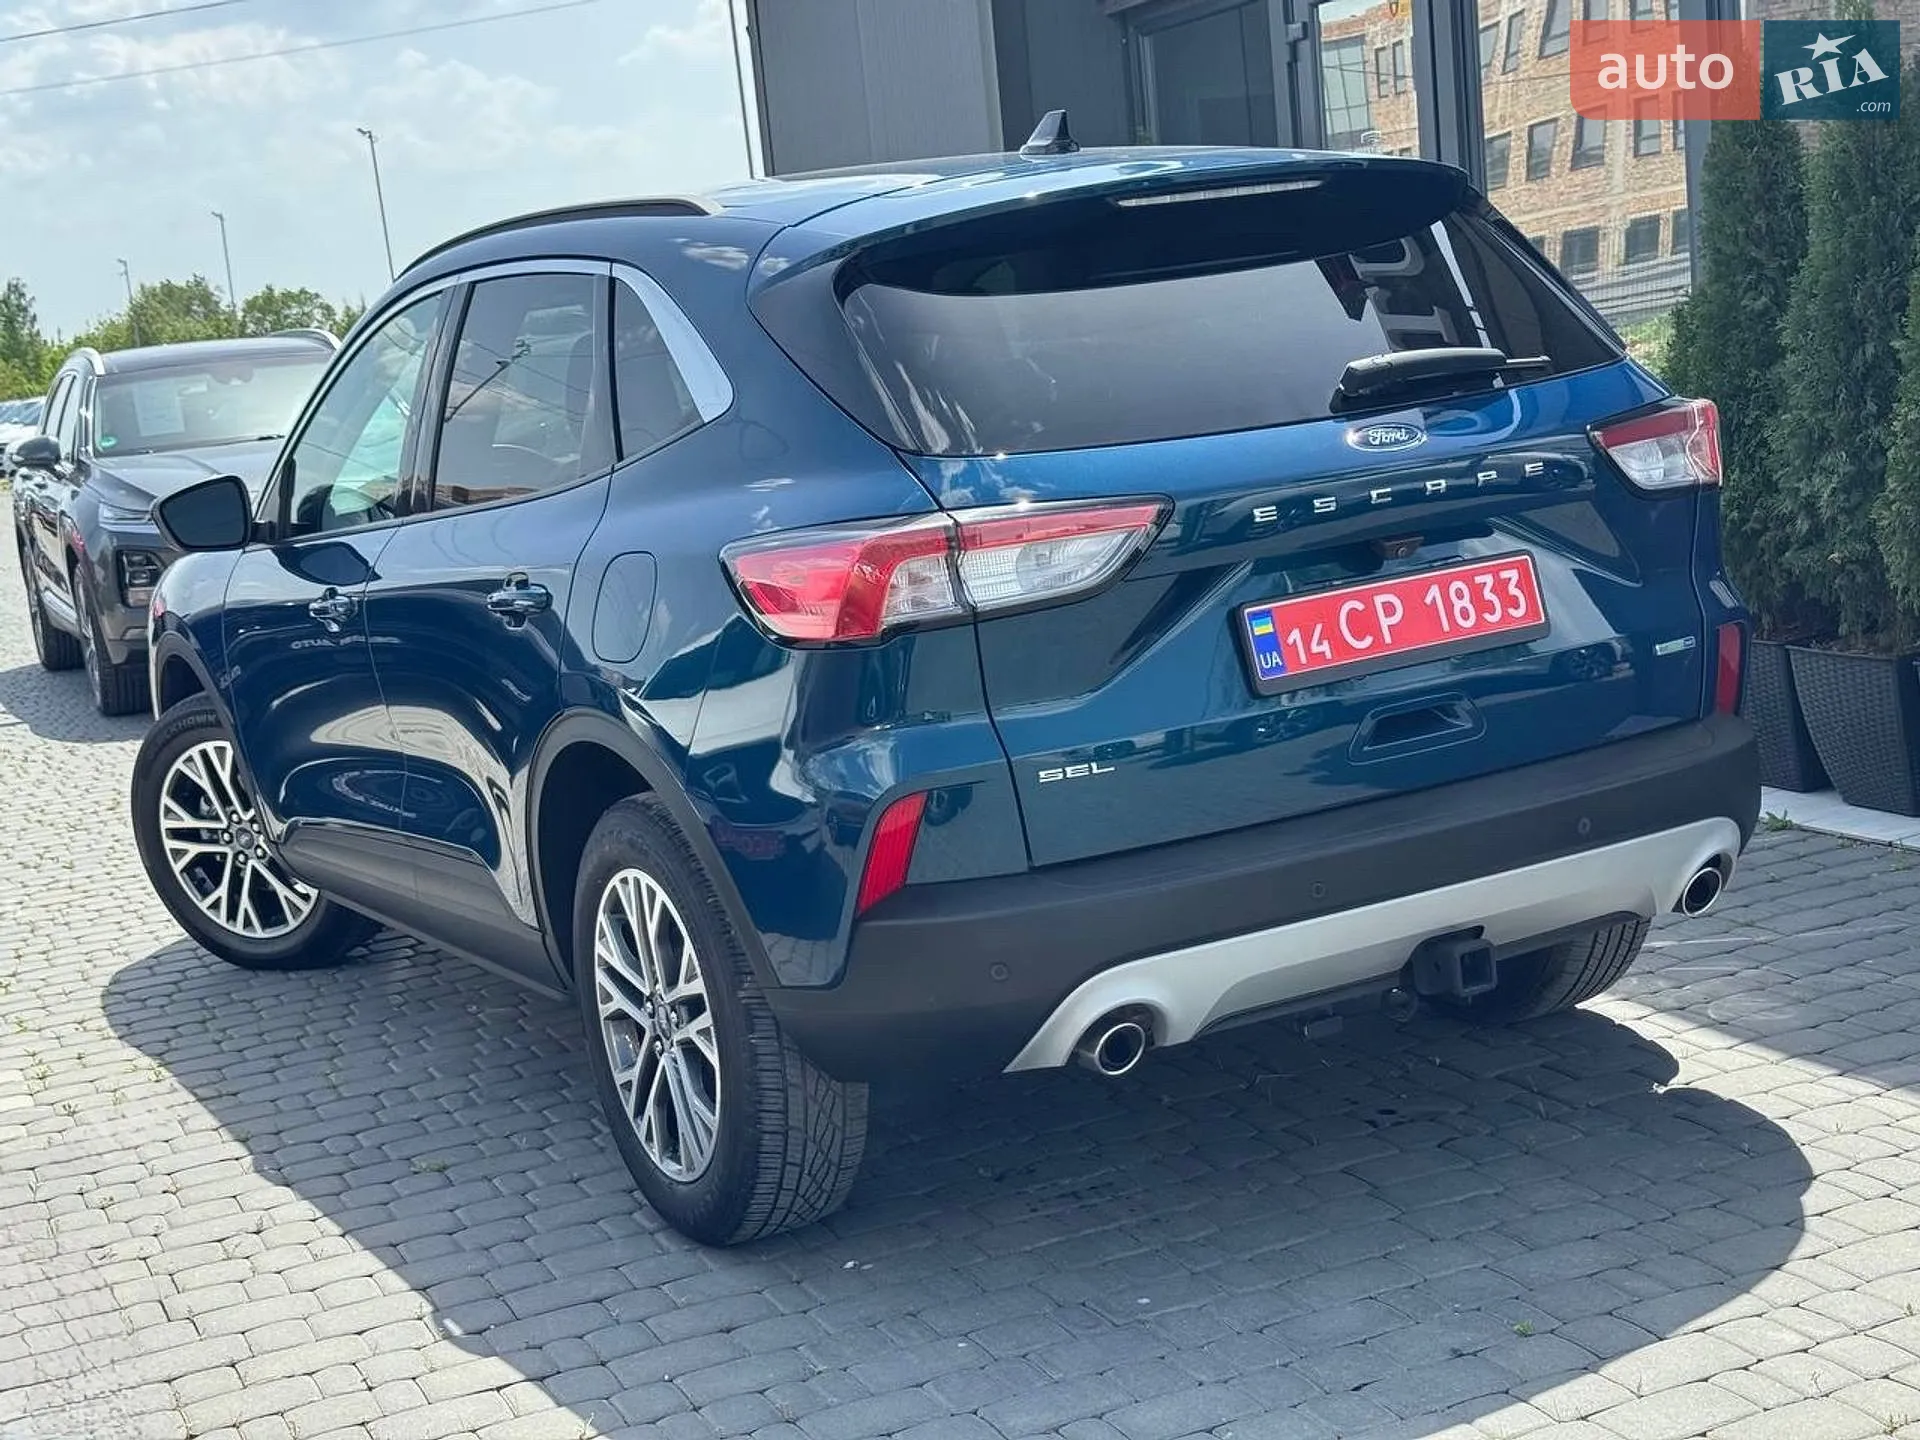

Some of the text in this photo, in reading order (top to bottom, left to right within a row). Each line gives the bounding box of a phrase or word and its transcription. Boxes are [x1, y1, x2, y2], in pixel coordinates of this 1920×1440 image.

[1367, 427, 1411, 446] Ford
[1252, 461, 1545, 523] ESCAPE
[1286, 623, 1333, 665] 14
[1423, 569, 1527, 633] 1833
[1260, 651, 1283, 669] UA
[1038, 761, 1116, 783] SEL
